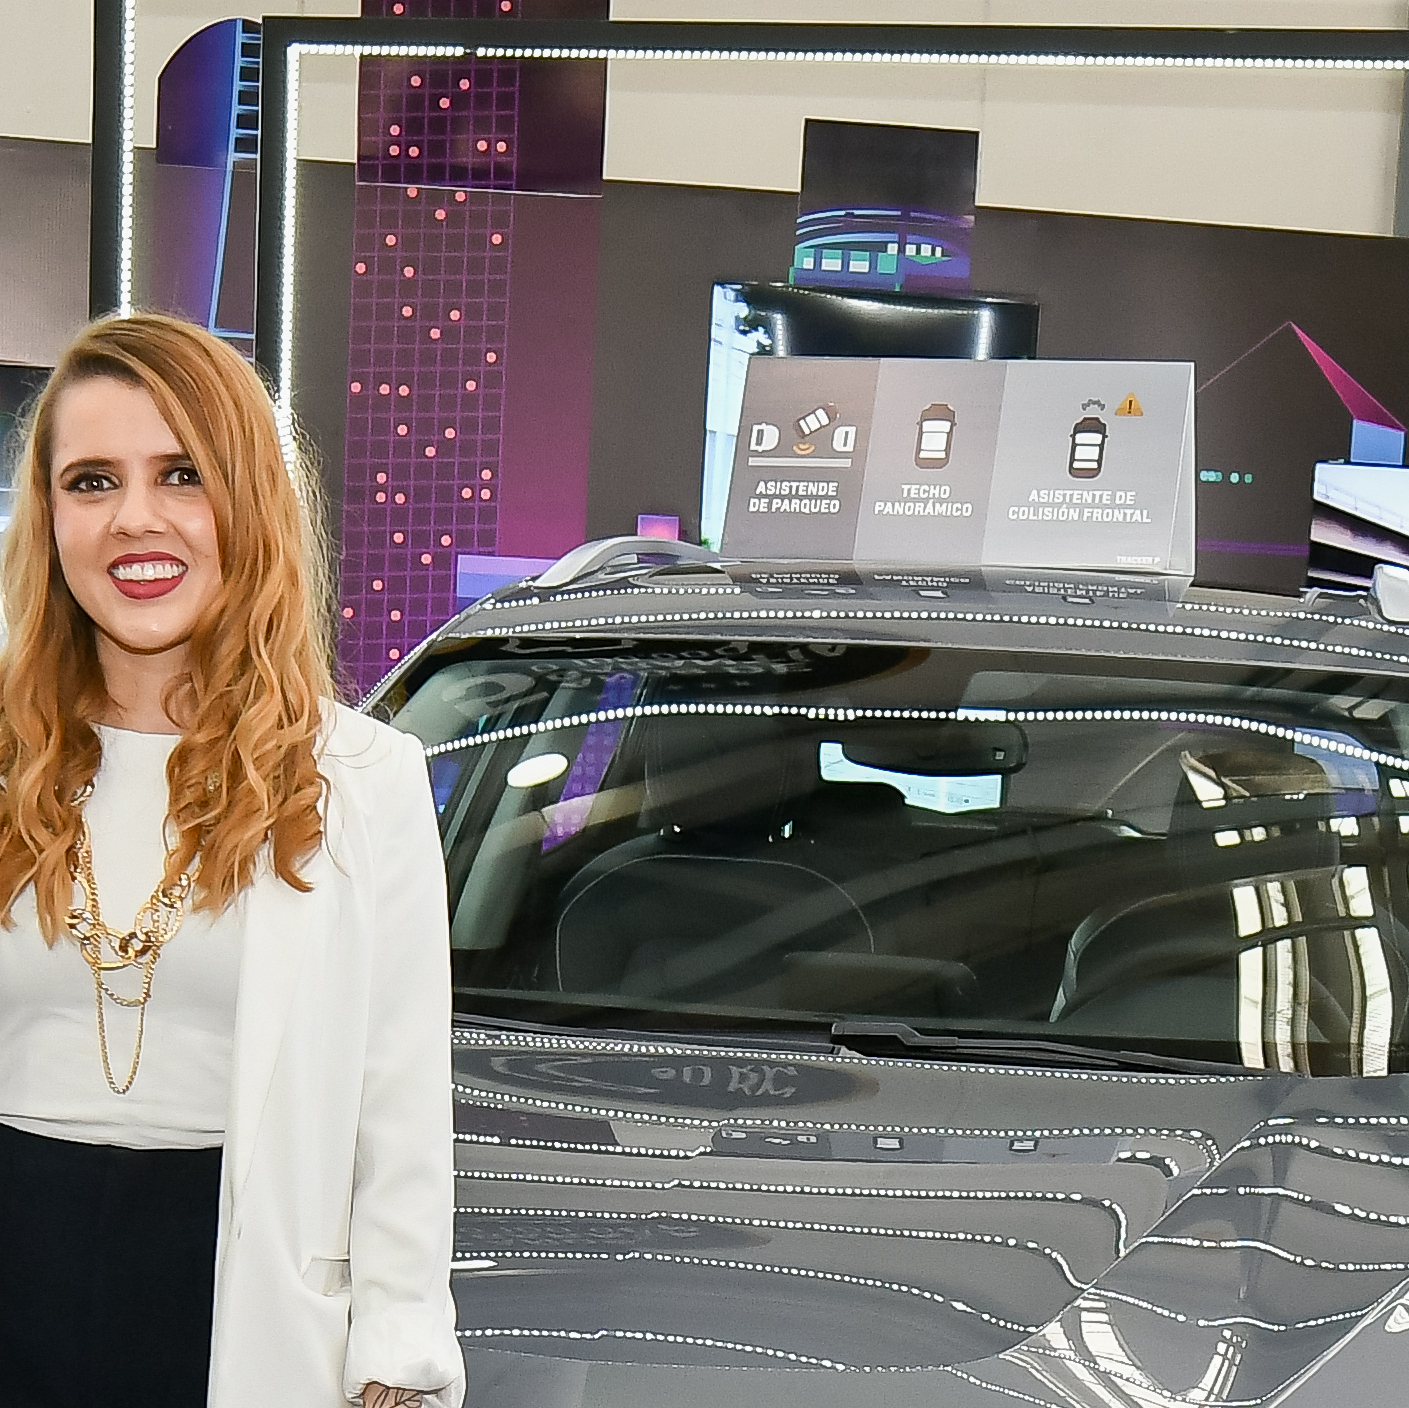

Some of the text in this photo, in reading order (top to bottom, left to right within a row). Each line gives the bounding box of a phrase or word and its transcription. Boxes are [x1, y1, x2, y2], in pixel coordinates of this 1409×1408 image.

[755, 480, 839, 496] ASISTENDE
[900, 484, 951, 499] TECHO
[1028, 489, 1136, 505] ASISTENTE DE
[748, 498, 841, 514] DE PARQUEO
[873, 500, 973, 517] PANORÁMICO
[1007, 504, 1152, 523] COLISIÓN FRONTAL
